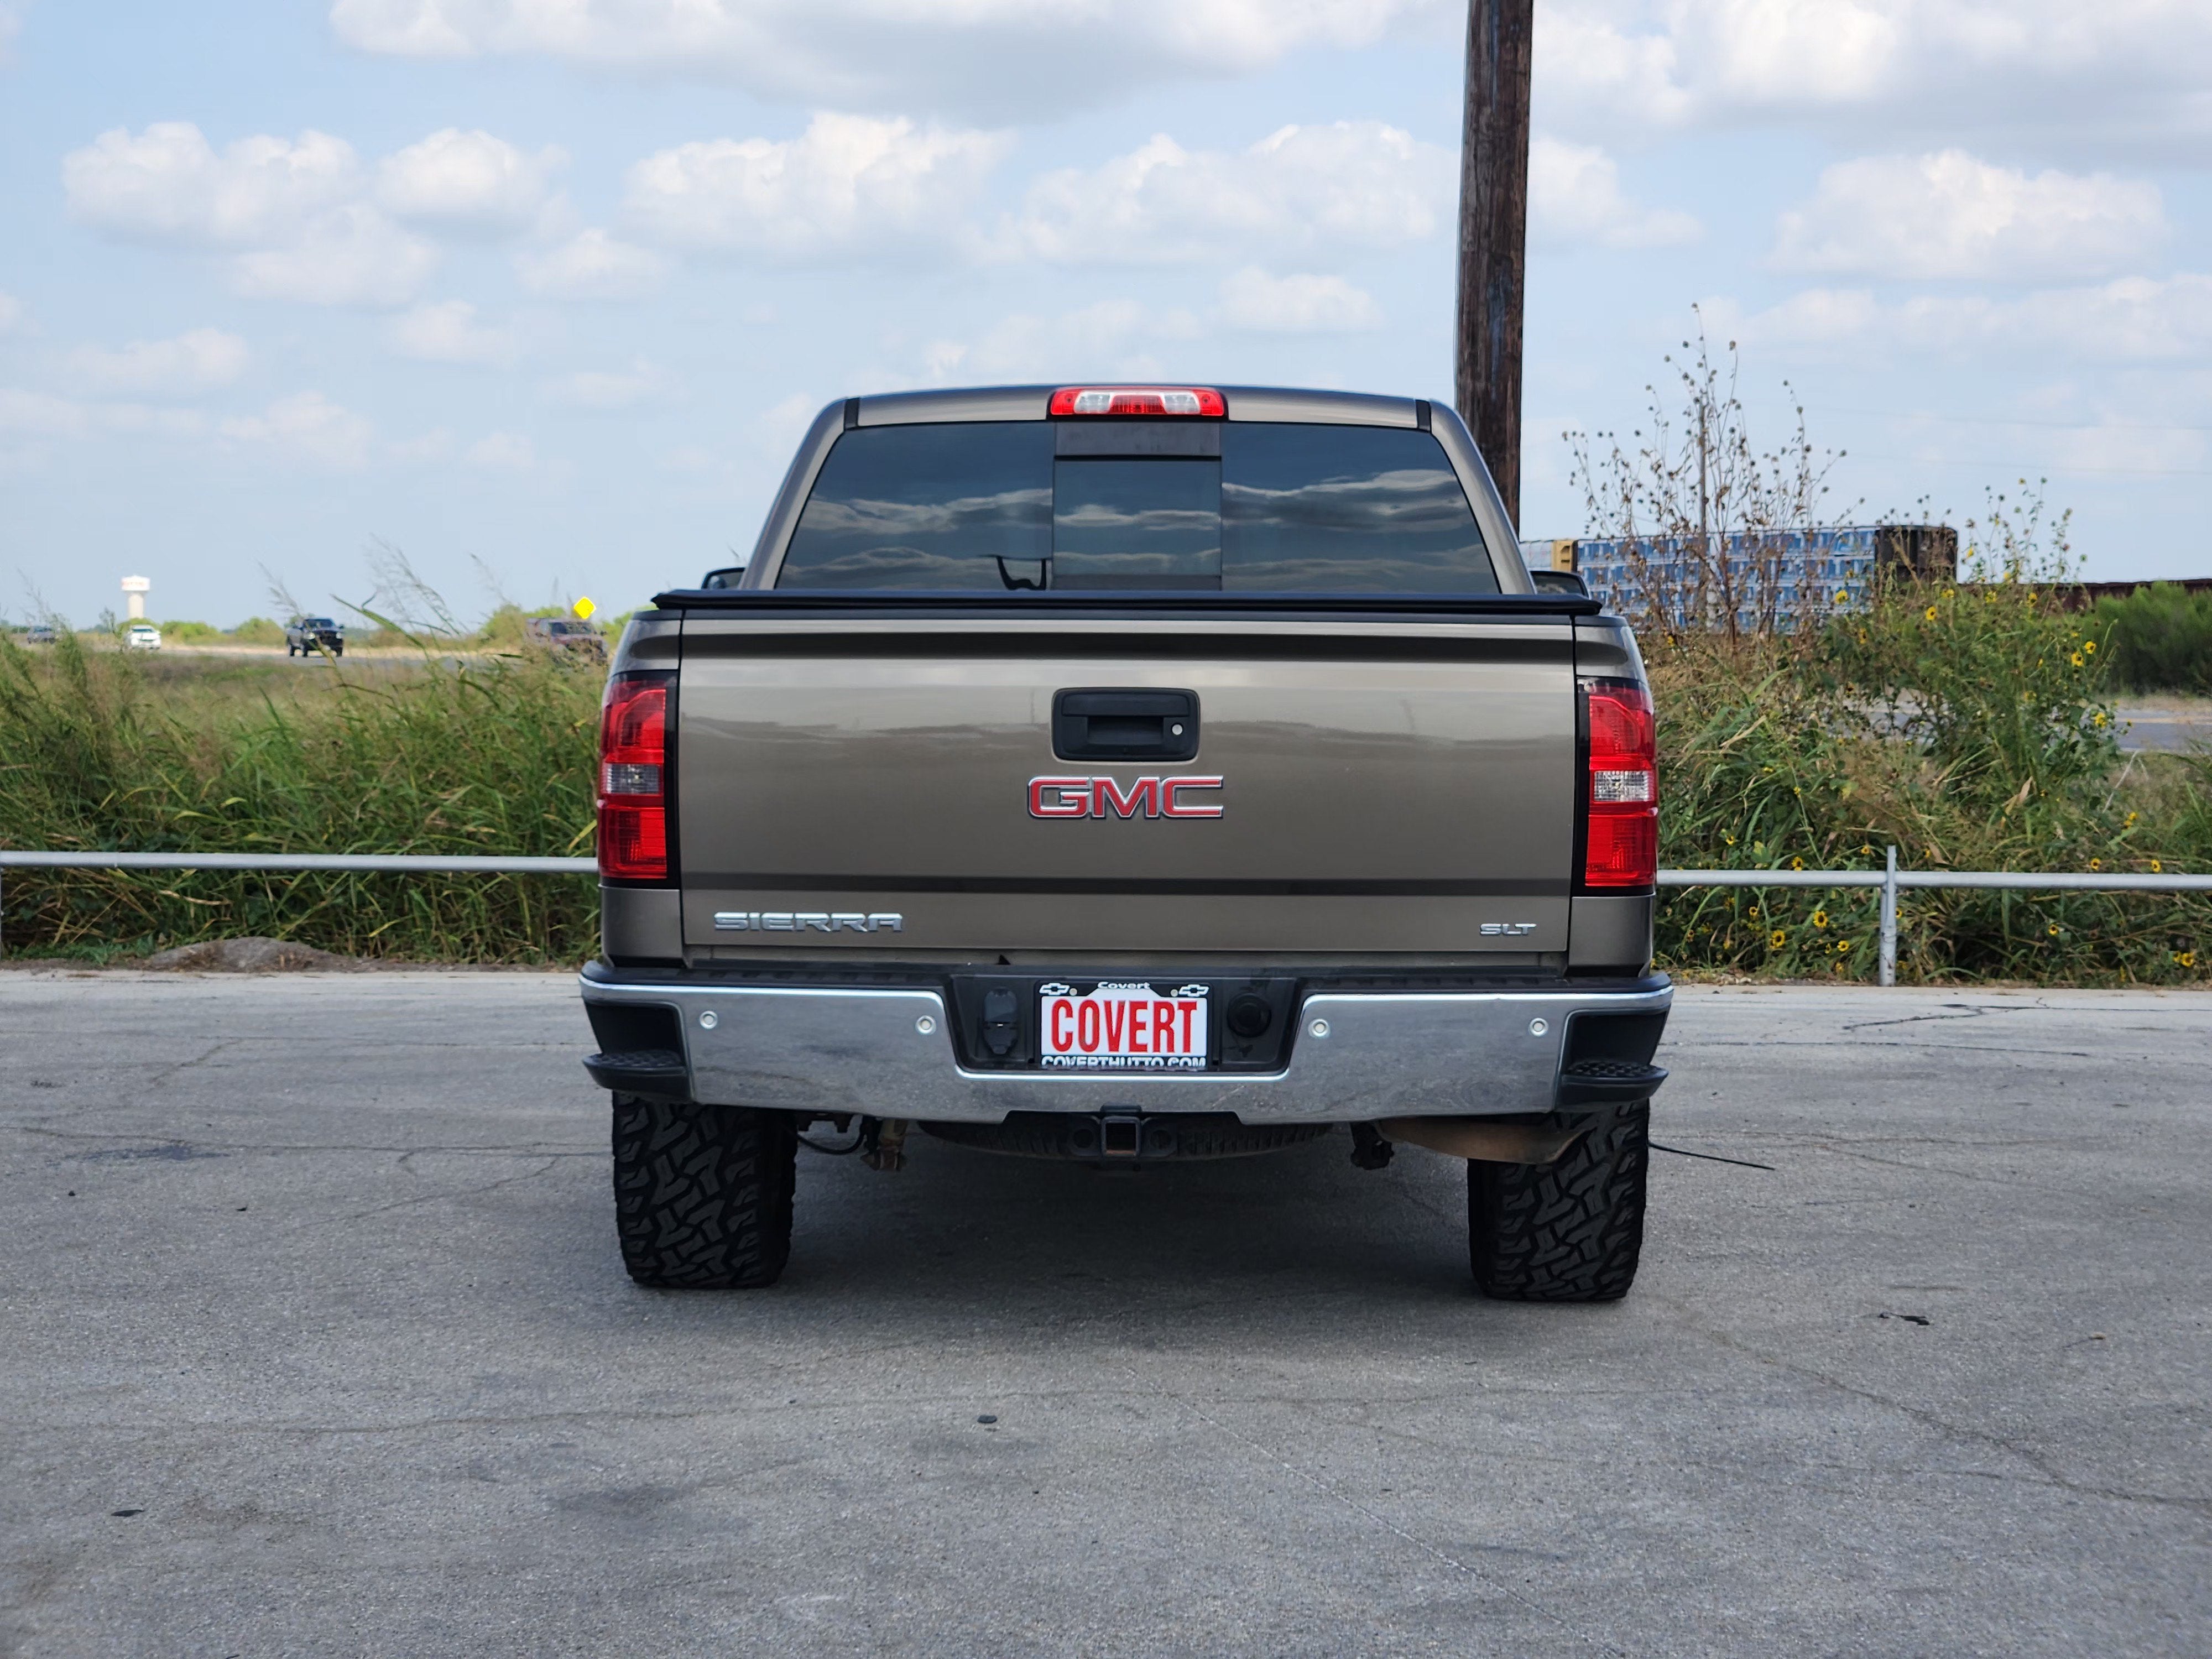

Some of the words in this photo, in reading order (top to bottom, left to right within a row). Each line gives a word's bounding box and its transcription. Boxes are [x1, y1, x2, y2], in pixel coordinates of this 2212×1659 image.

[1028, 775, 1224, 818] GMC
[714, 912, 903, 932] SIERRA
[1480, 923, 1537, 935] SLT
[1097, 981, 1150, 990] Covert
[1051, 999, 1198, 1053] COVERT
[1041, 1056, 1206, 1067] COVERTHUTTOCOM
